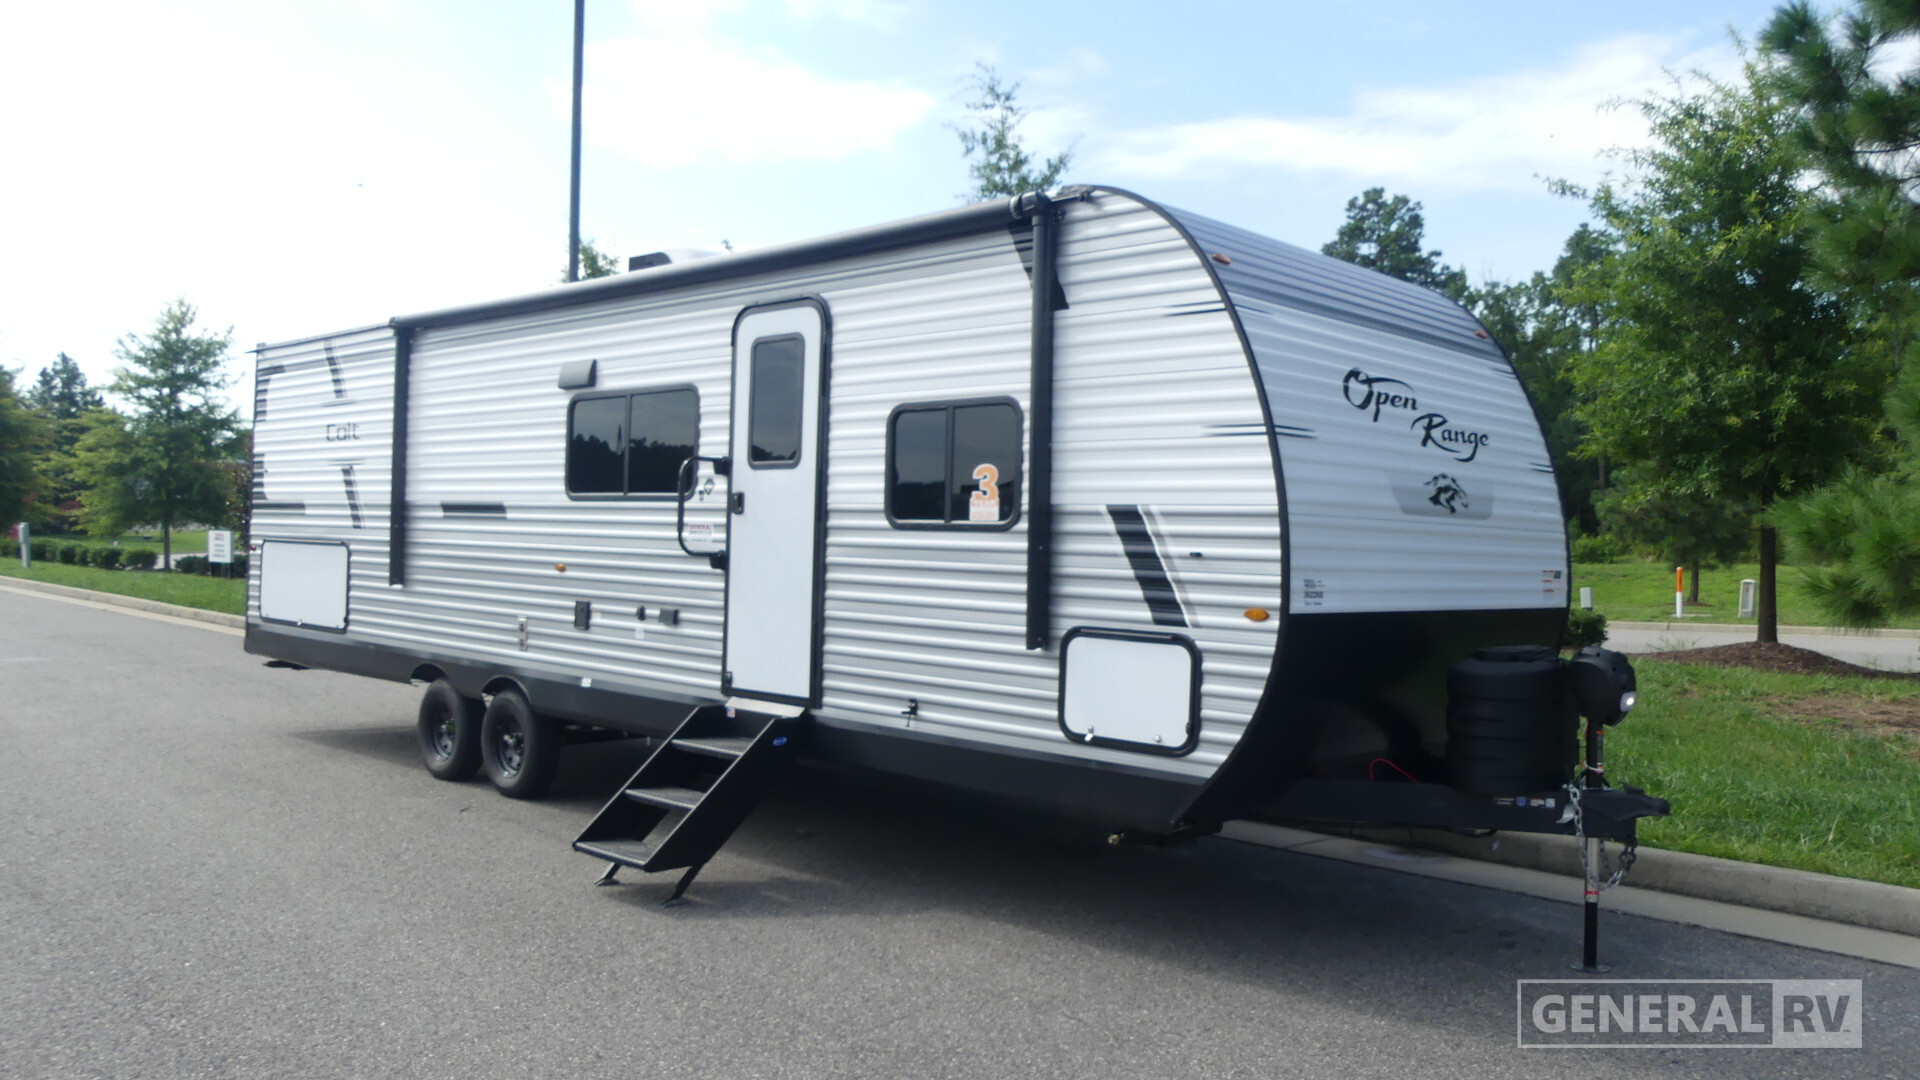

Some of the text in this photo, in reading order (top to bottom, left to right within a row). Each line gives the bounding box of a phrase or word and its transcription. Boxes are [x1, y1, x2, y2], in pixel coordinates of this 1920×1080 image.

[1342, 367, 1418, 423] Open
[1411, 413, 1489, 462] Range
[972, 463, 999, 500] 3
